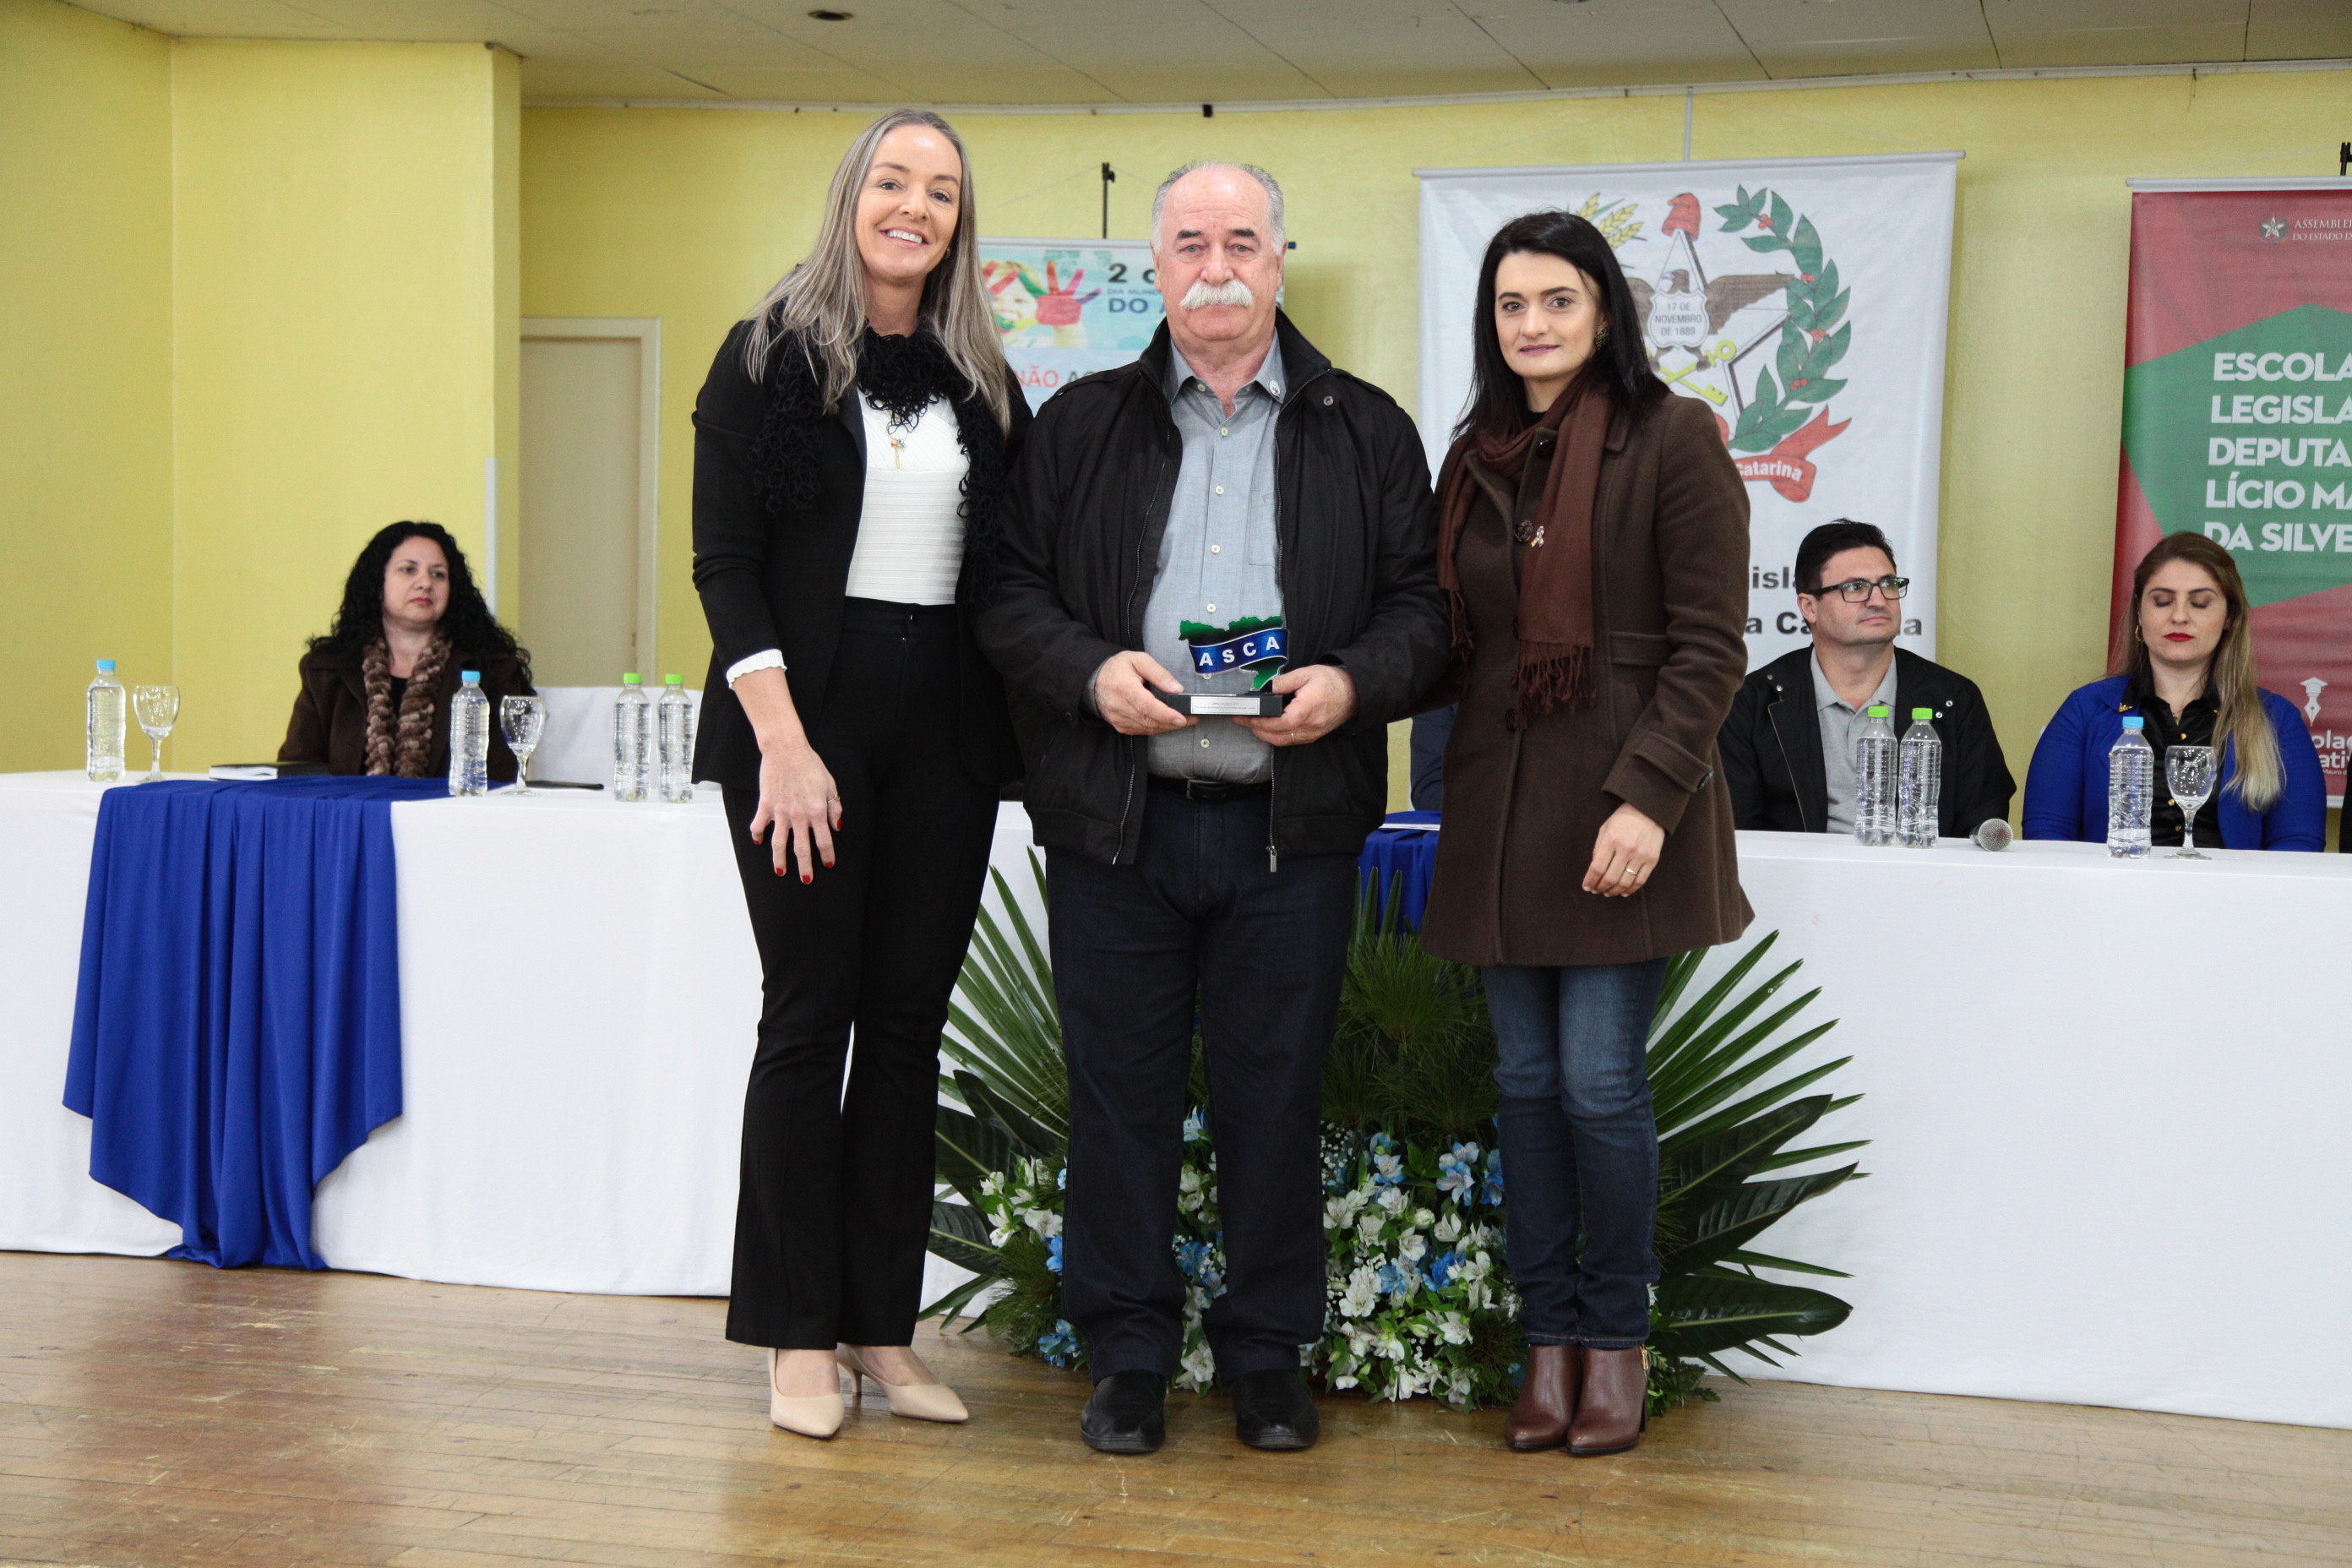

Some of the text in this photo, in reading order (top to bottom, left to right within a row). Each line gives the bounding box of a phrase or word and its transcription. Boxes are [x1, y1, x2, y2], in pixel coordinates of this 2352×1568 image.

[2292, 232, 2307, 241] DO
[2309, 232, 2343, 241] ESTADO
[1108, 263, 1127, 283] 2
[1108, 297, 1148, 313] DO
[1680, 303, 1690, 312] DE
[1655, 314, 1702, 324] NOVEMBRO
[1661, 327, 1672, 336] DE
[2208, 438, 2352, 466] DEPUTA
[2206, 471, 2306, 509] LÍCIO
[2204, 521, 2254, 551] DA
[1199, 636, 1280, 667] ASCA
